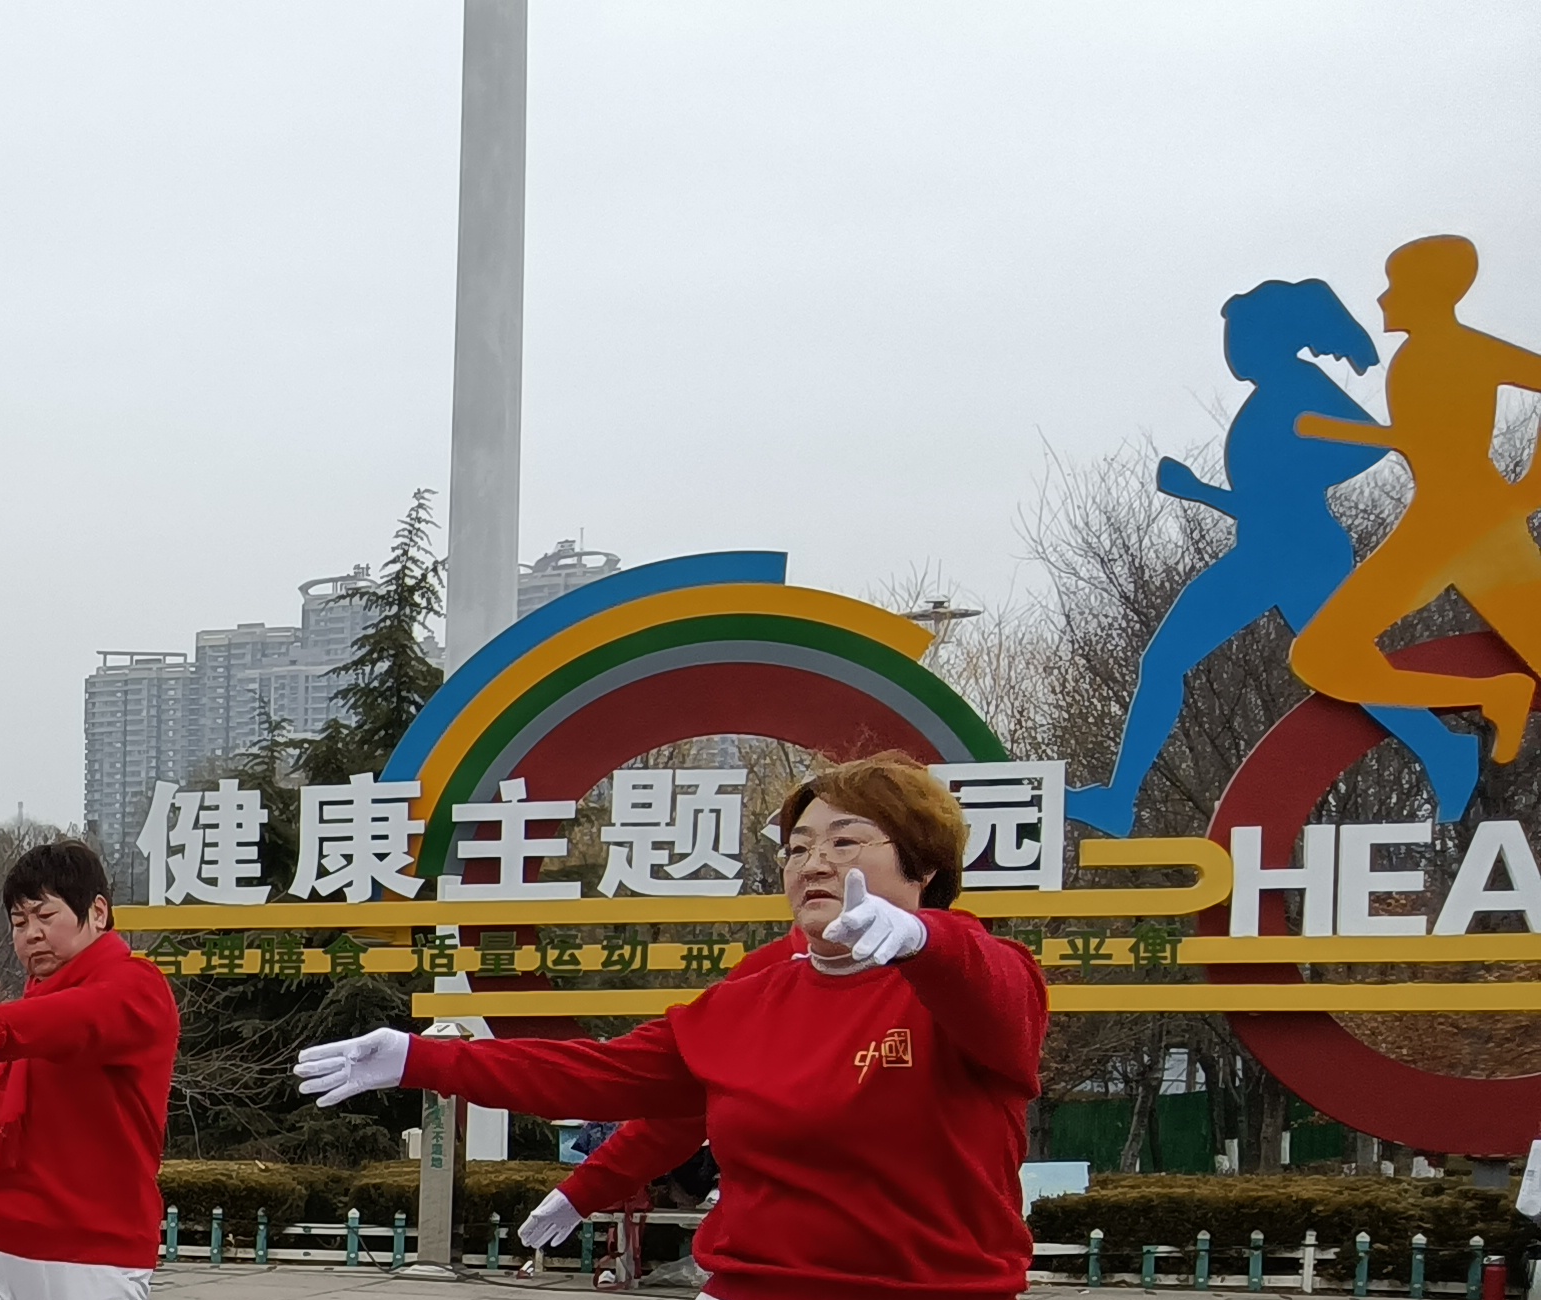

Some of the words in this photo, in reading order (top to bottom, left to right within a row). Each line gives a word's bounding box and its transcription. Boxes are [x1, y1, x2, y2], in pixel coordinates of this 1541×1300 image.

[136, 761, 1066, 907] 健康主题园
[1229, 818, 1541, 938] HEA
[145, 932, 368, 979] 合理膳食
[414, 930, 650, 978] 适量运动
